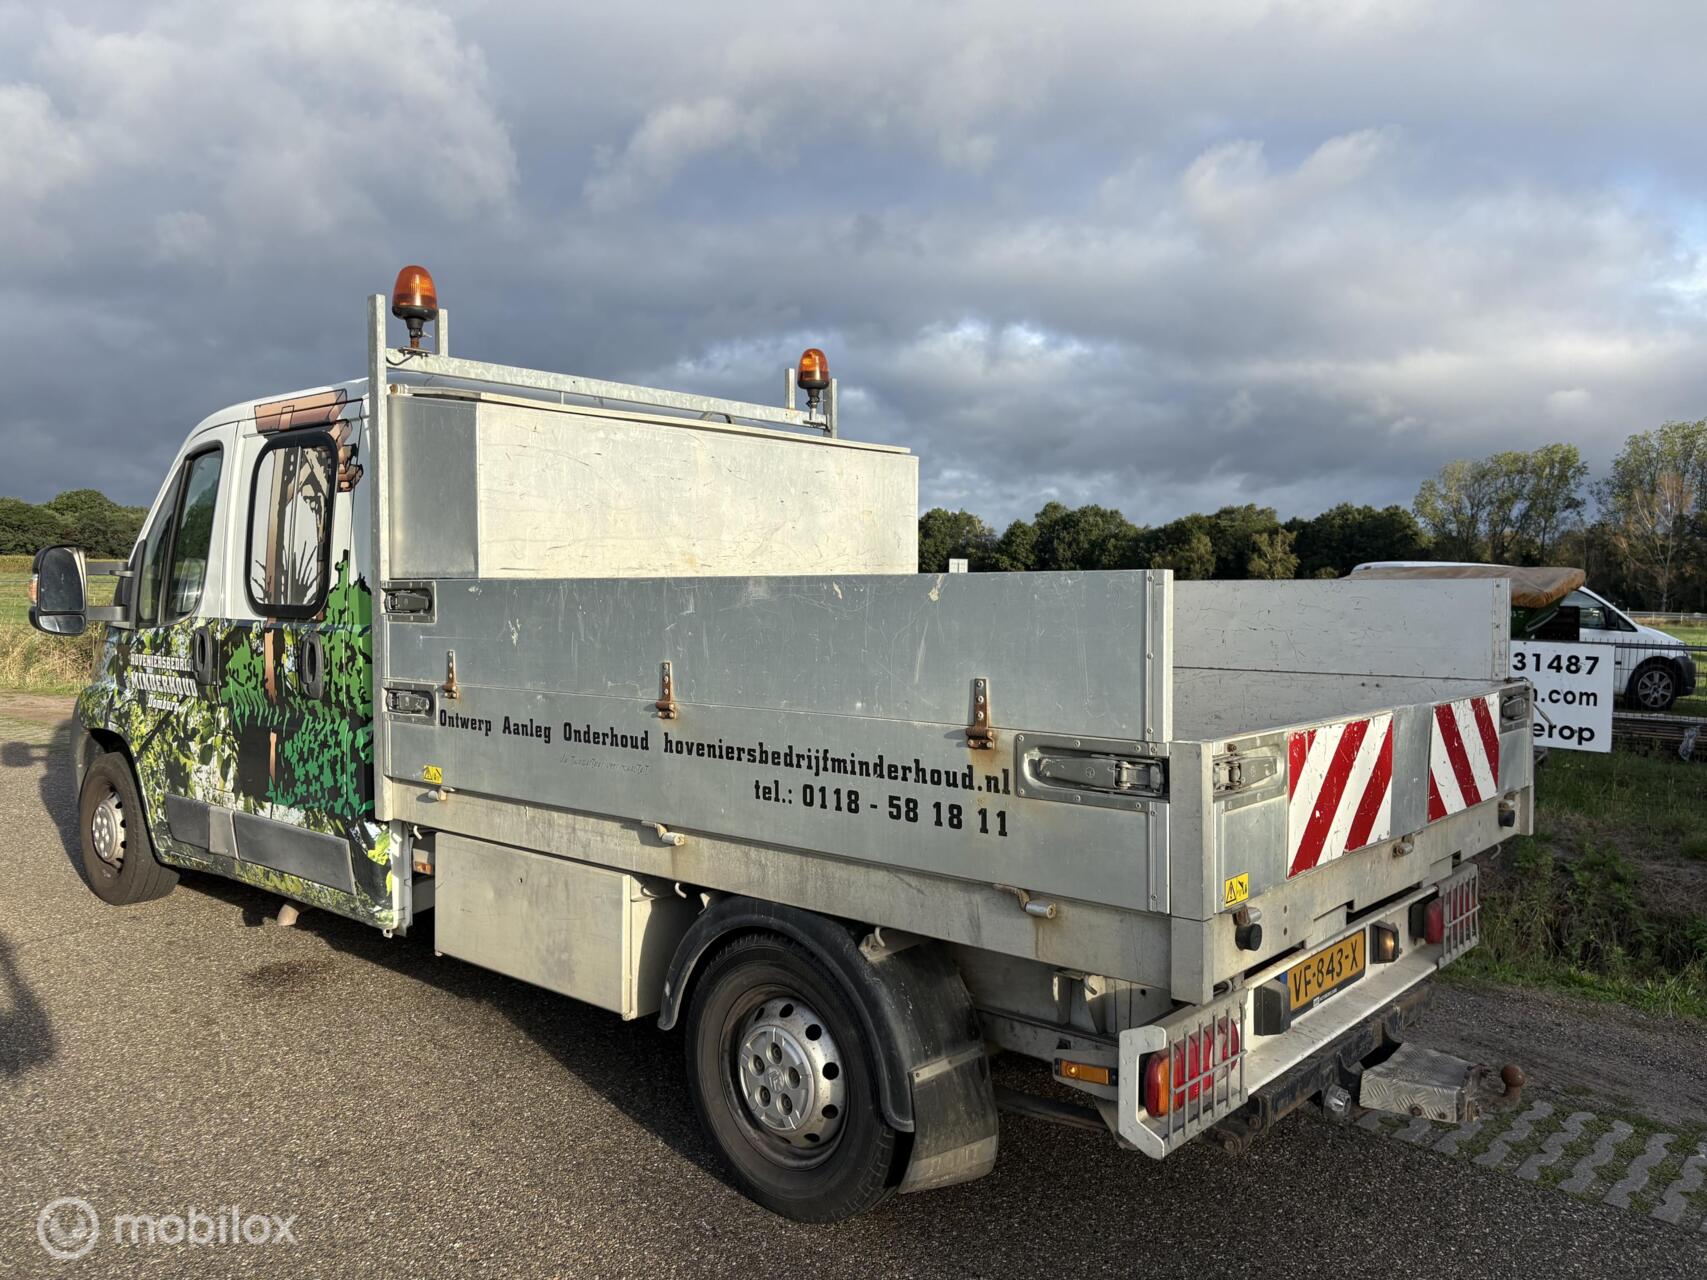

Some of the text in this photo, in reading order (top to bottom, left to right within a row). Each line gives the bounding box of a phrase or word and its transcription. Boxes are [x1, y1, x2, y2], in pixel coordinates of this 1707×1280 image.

[131, 672, 198, 696] MINDERHOUD
[1512, 652, 1600, 675] 31487
[148, 694, 179, 714] Domburg
[439, 709, 492, 736] Ontwerp
[502, 715, 552, 744] Aanleg
[563, 721, 650, 750] Onderhoud
[663, 732, 1012, 796] hoveniersbedrijfminderhoud.nl
[754, 779, 794, 805] tel.:
[802, 783, 860, 815] 0118
[888, 794, 919, 823] 58
[933, 801, 963, 830] 18
[978, 807, 1008, 837] 11
[1293, 939, 1359, 1003] VF-843-X
